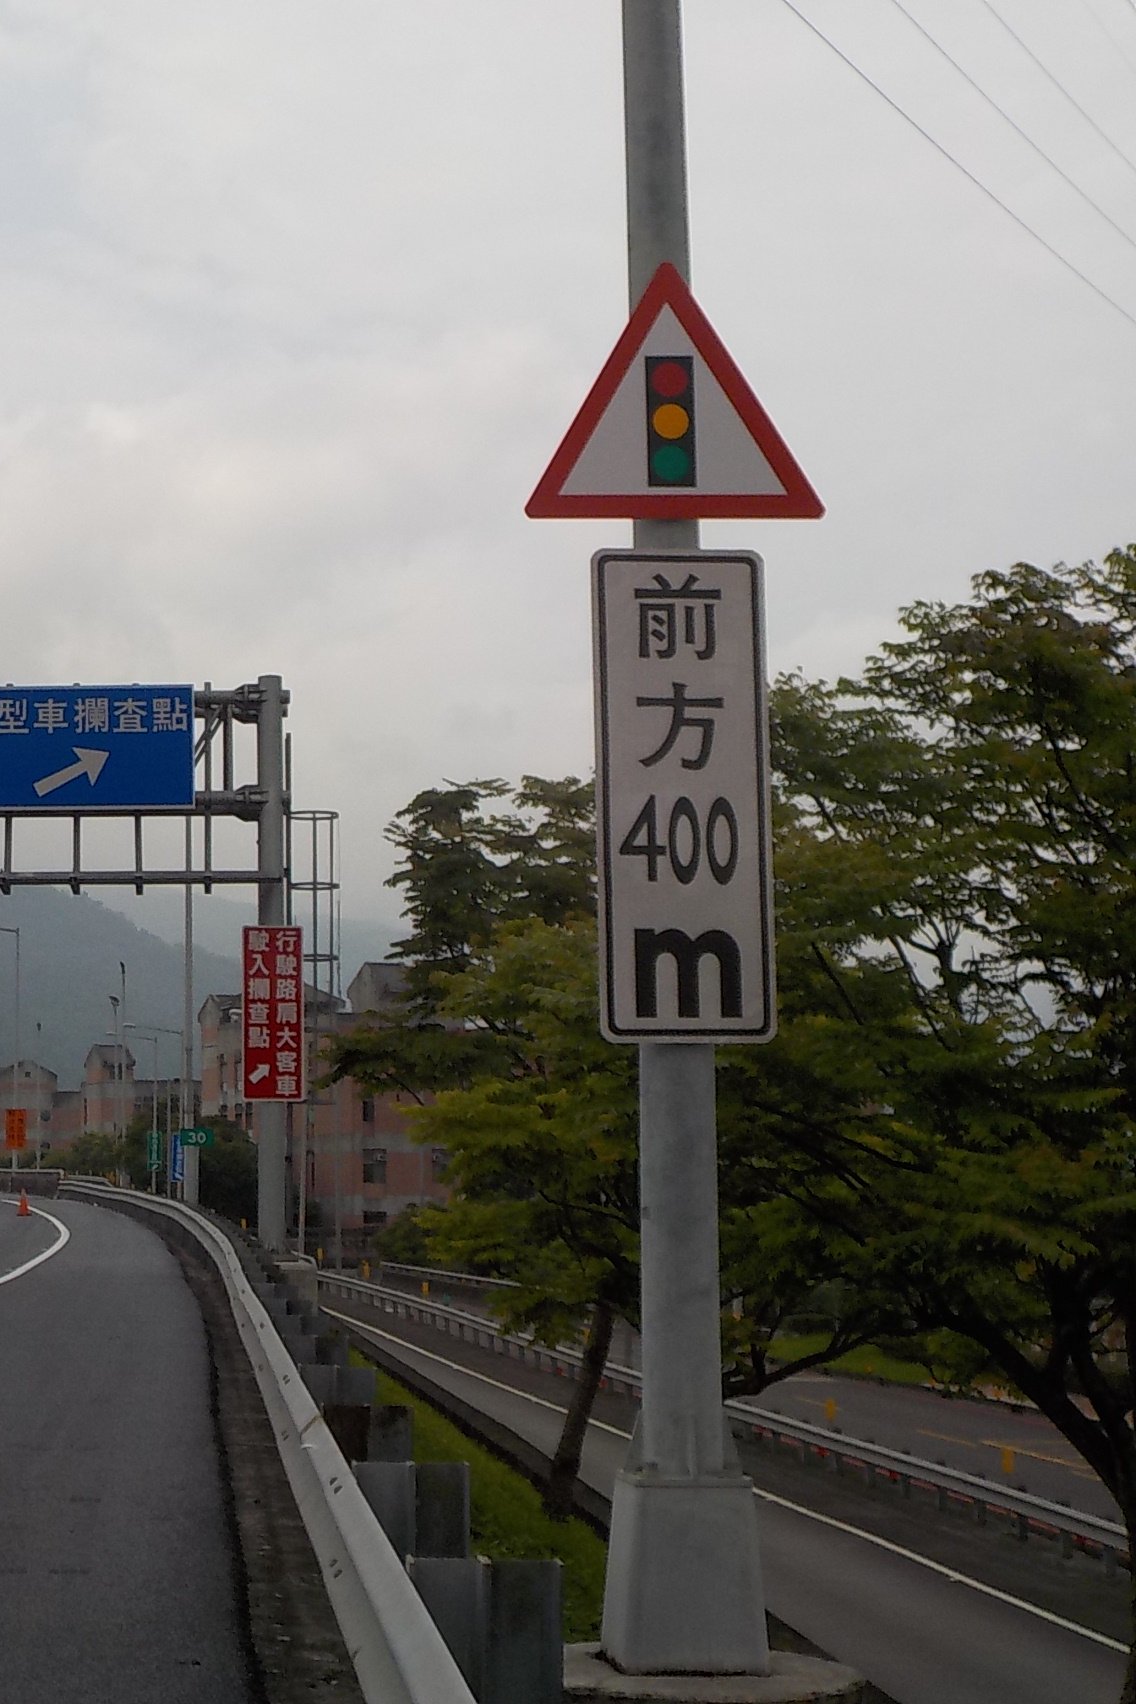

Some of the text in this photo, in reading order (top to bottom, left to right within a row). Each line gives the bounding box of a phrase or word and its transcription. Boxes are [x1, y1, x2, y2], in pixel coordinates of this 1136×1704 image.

[634, 573, 725, 772] 前方
[619, 794, 740, 886] 400
[248, 930, 271, 1049] 駛入攔查點
[275, 930, 298, 1096] 行駛路肩大客車
[634, 928, 743, 1019] m
[187, 1131, 207, 1144] 30
